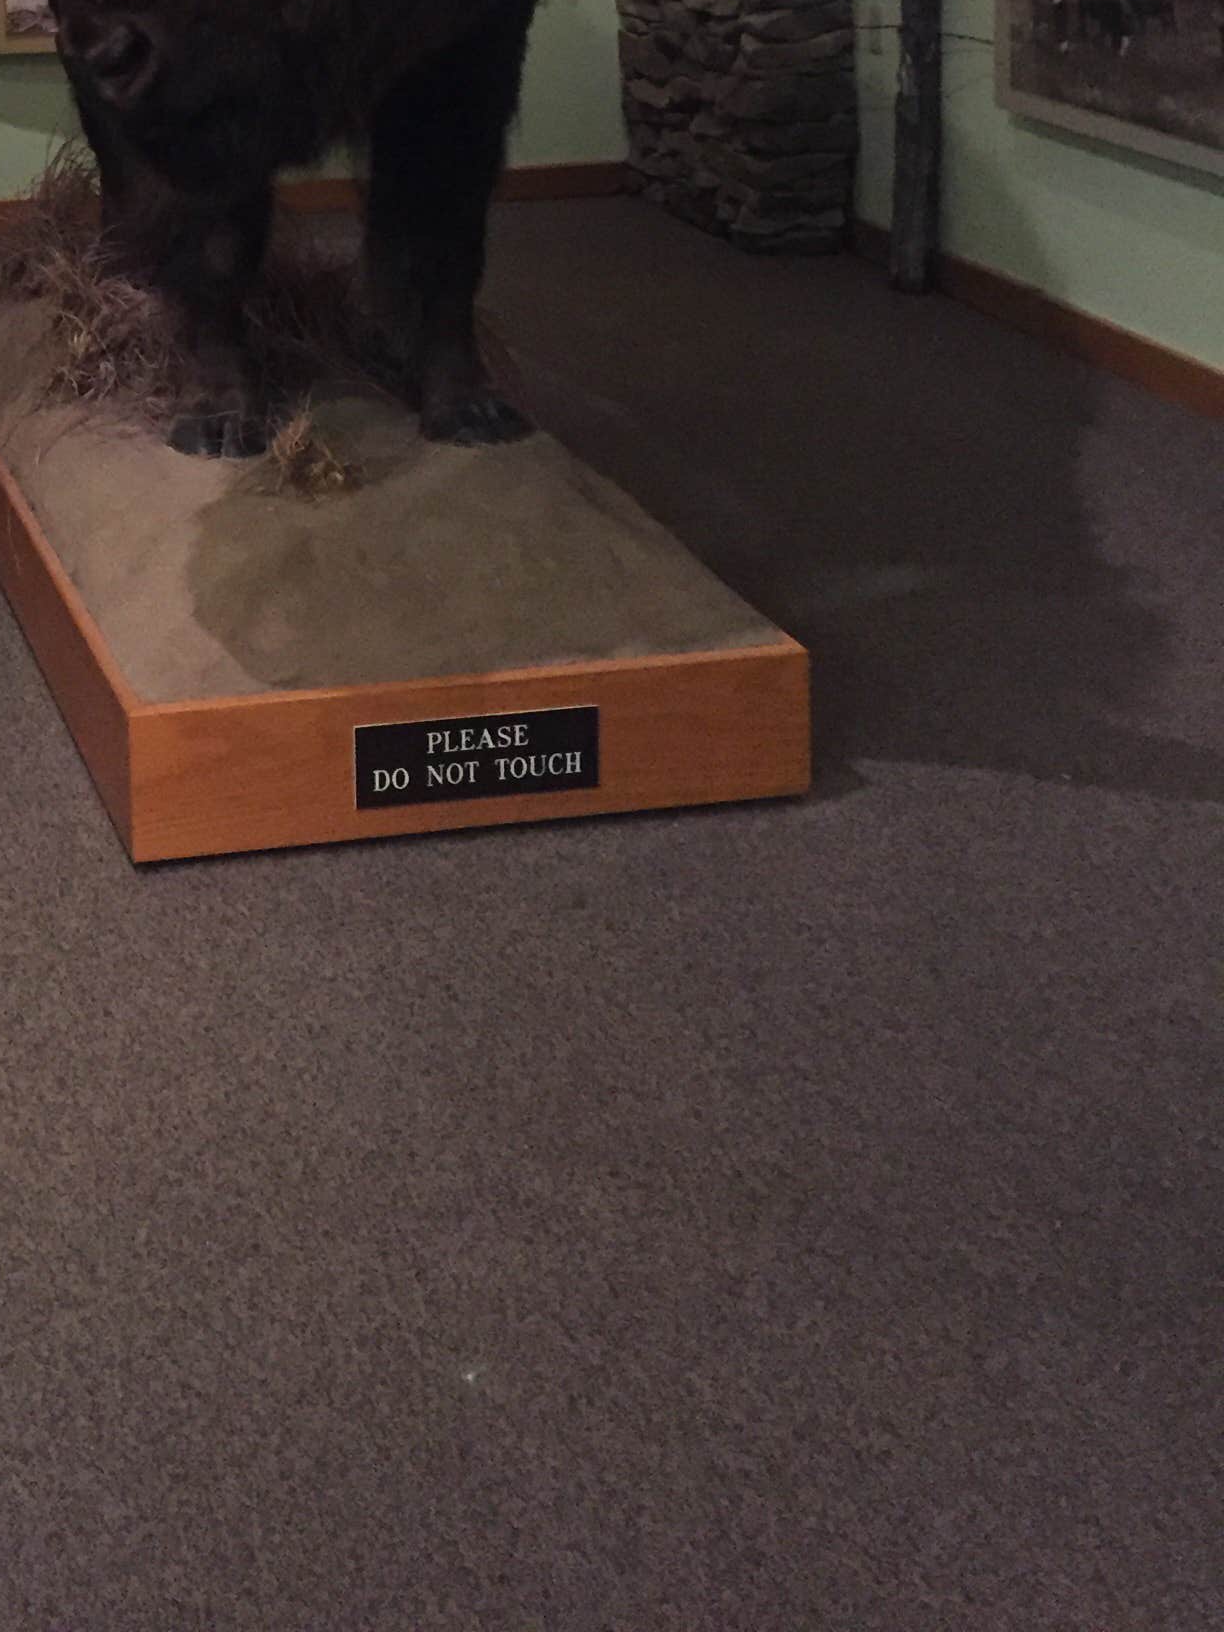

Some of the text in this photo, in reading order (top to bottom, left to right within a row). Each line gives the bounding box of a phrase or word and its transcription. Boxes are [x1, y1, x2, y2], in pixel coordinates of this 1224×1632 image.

[427, 724, 529, 754] PLEASE
[374, 751, 582, 792] DO NOT TOUCH
